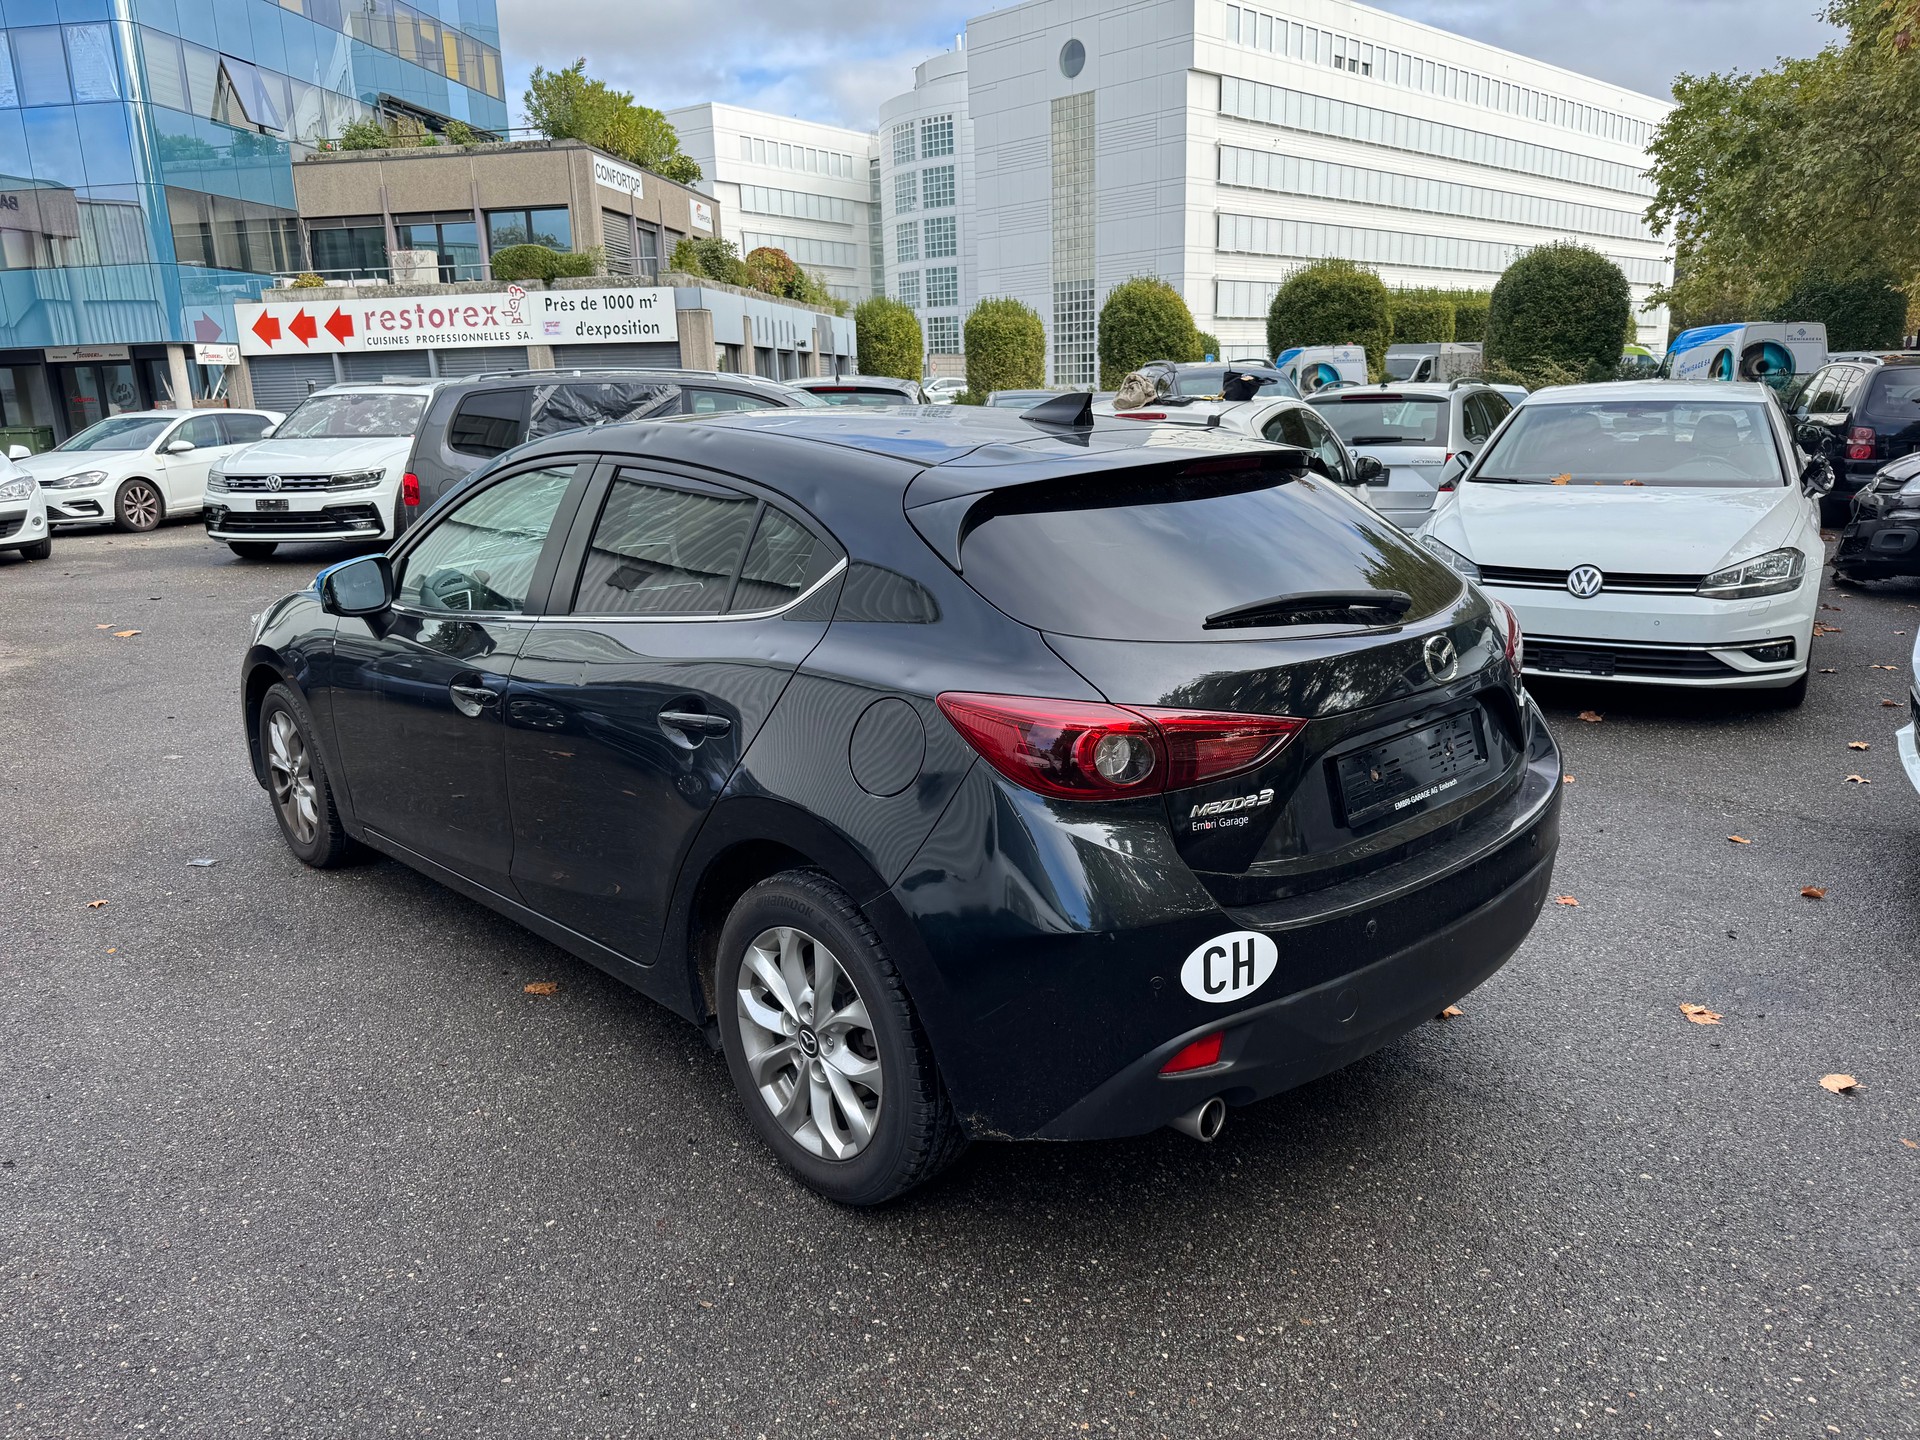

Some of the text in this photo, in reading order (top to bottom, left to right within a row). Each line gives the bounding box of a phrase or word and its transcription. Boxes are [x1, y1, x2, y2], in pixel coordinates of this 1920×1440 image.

[595, 163, 641, 192] CONFORTOP
[544, 296, 576, 312] Près
[580, 296, 598, 310] de
[602, 294, 635, 310] 1000
[364, 304, 500, 331] restorex
[366, 331, 534, 346] CUISINES PROFESSIONNELLES SA.
[575, 320, 660, 339] d'exposition
[1394, 778, 1458, 810] EMBRI-GARAGE AG Embrach
[1191, 816, 1249, 831] Embri Garage
[1203, 937, 1255, 995] CH
